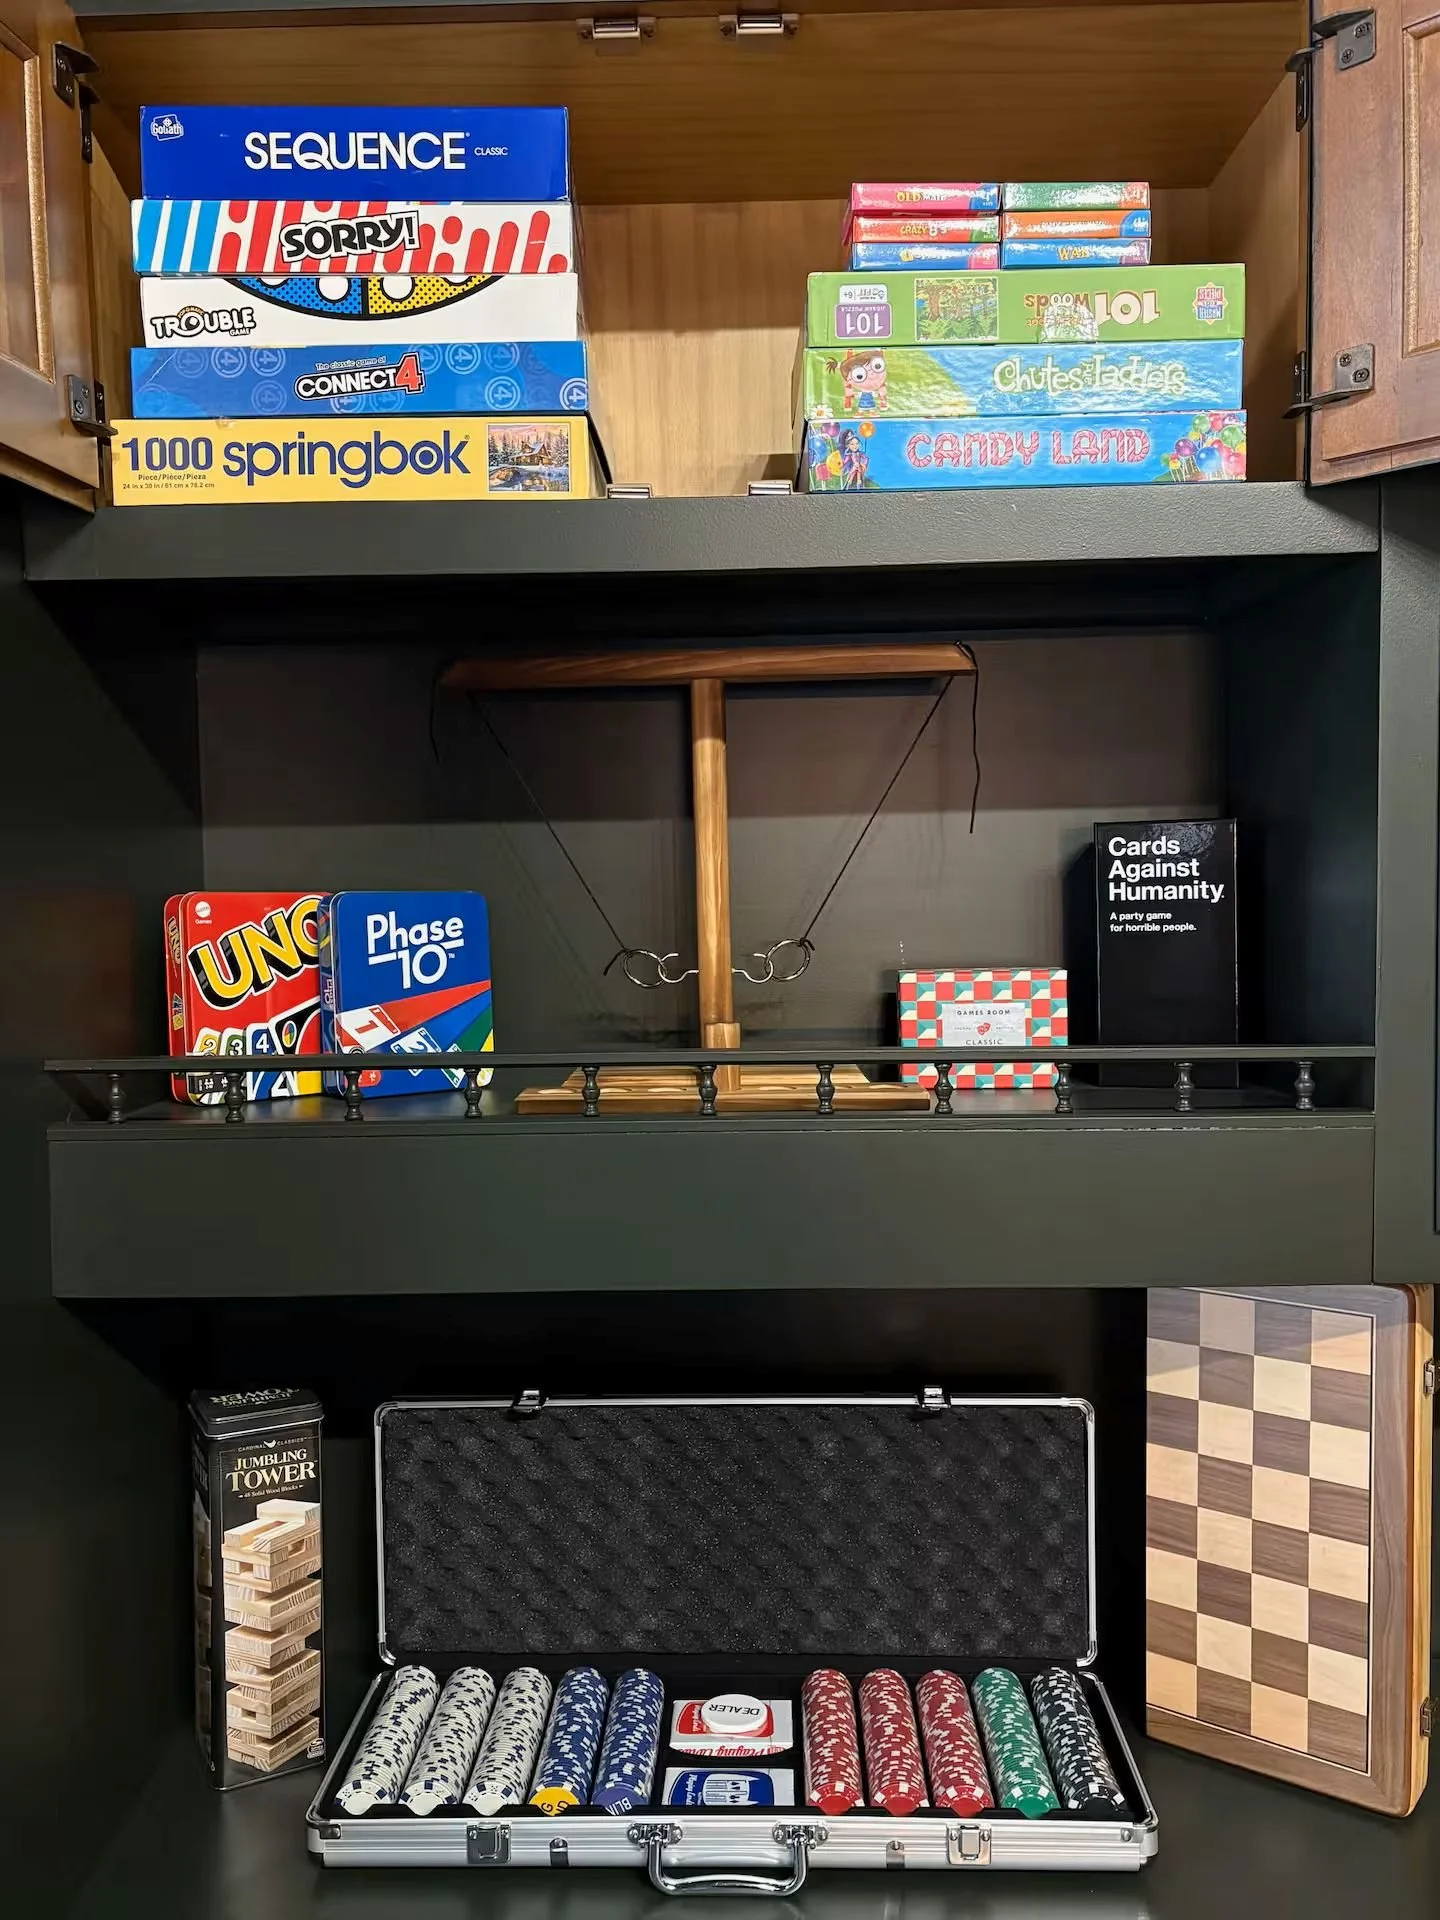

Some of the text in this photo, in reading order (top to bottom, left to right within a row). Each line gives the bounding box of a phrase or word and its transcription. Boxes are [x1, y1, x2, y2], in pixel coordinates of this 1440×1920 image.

[152, 122, 182, 135] Goliath
[244, 131, 466, 170] SEQUENCE
[474, 147, 508, 156] CLASSIC
[896, 191, 921, 202] OLD
[283, 215, 417, 257] SORRY!
[900, 225, 928, 235] CRAZY
[1095, 290, 1160, 325] 101
[151, 307, 256, 339] TROUBLE
[230, 328, 250, 336] GAME
[846, 312, 884, 335] 101
[993, 355, 1083, 396] Chutes
[1093, 353, 1186, 394] Ladders
[122, 430, 471, 489] 1000 springbok
[907, 428, 1151, 468] CANDY LAND
[1108, 835, 1181, 857] Cards
[1108, 858, 1200, 883] Against
[1109, 880, 1225, 903] Humanity.
[1109, 912, 1172, 922] A party game
[1110, 922, 1197, 933] for horrible people.
[367, 911, 464, 955] Phase
[188, 897, 320, 1006] UNO
[397, 944, 447, 989] 10
[256, 1033, 269, 1053] 4
[238, 1437, 305, 1452] CARDINAL CLASSICS
[234, 1449, 307, 1471] JUMBLING
[225, 1461, 317, 1492] TOWER
[252, 1489, 266, 1497] Solid
[281, 1484, 299, 1492] Blocks
[708, 1704, 760, 1716] DEALER
